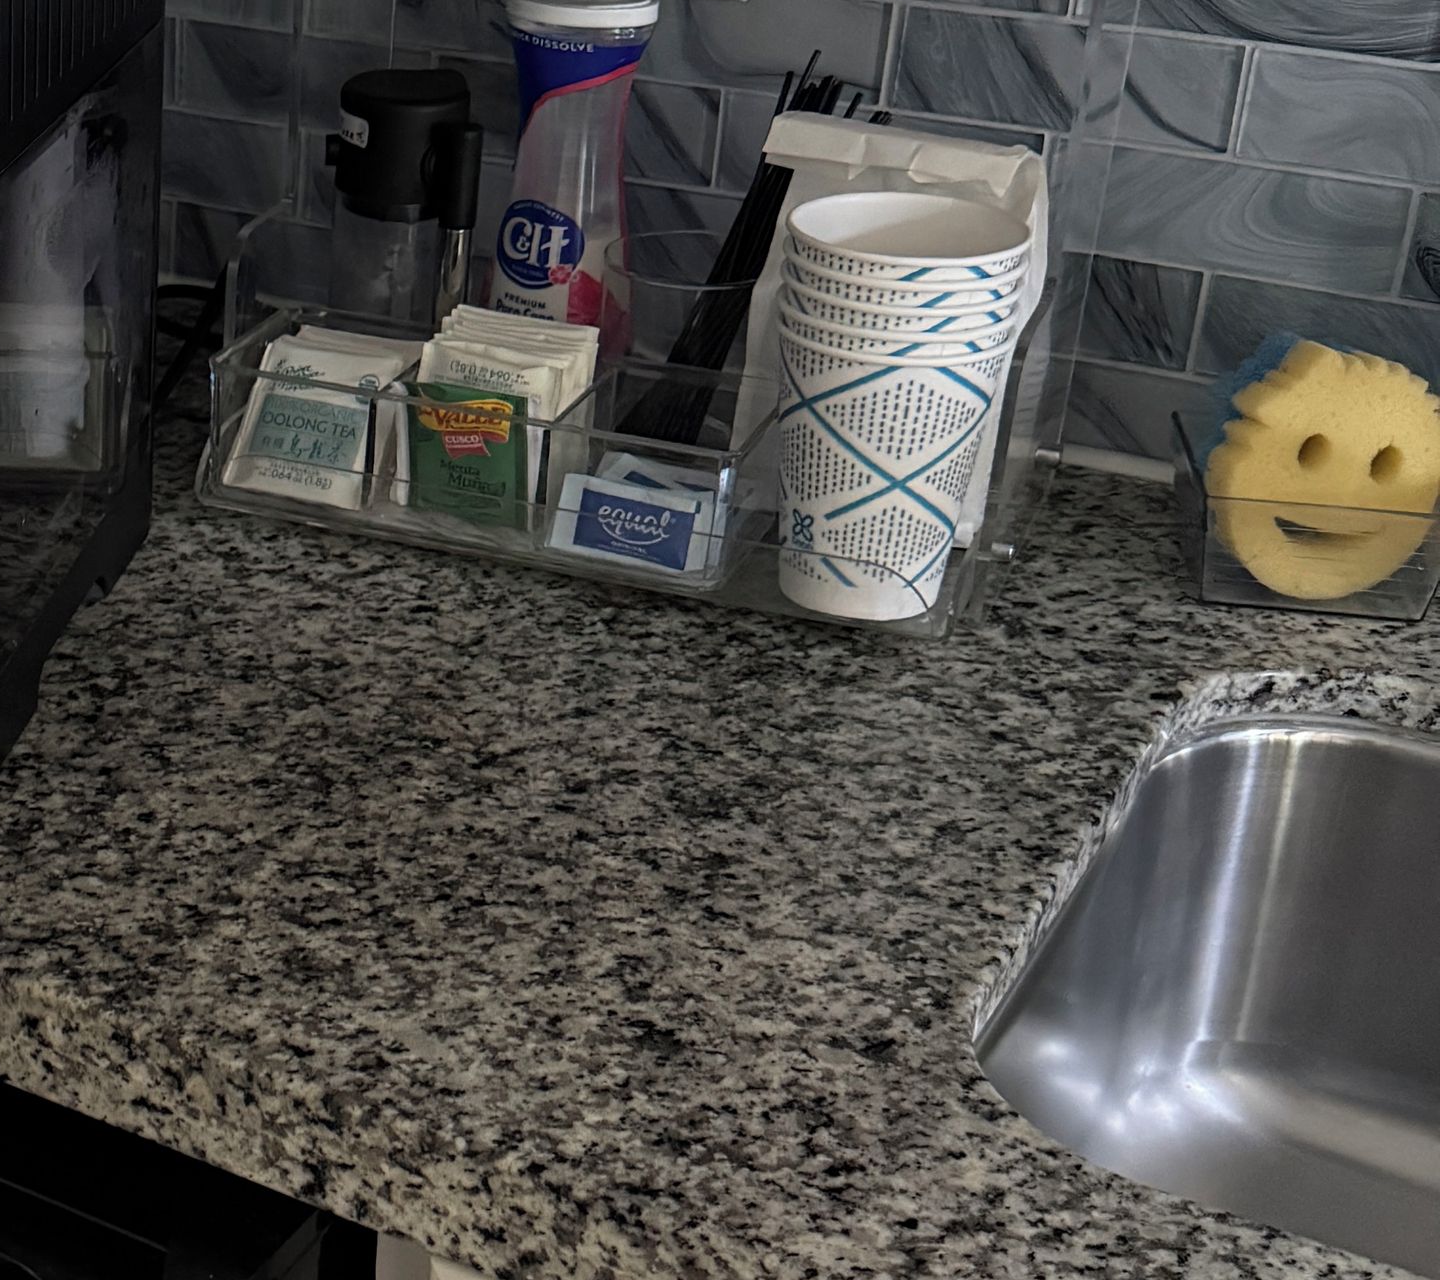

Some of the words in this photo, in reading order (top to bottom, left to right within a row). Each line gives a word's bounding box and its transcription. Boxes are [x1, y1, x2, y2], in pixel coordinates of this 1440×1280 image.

[532, 36, 595, 53] DISSOLVE
[502, 216, 570, 269] C&H
[504, 292, 547, 310] PREMIUM
[262, 410, 328, 434] OOLONG
[331, 422, 357, 440] TEA
[445, 434, 480, 444] CUSCO
[597, 504, 670, 539] equal
